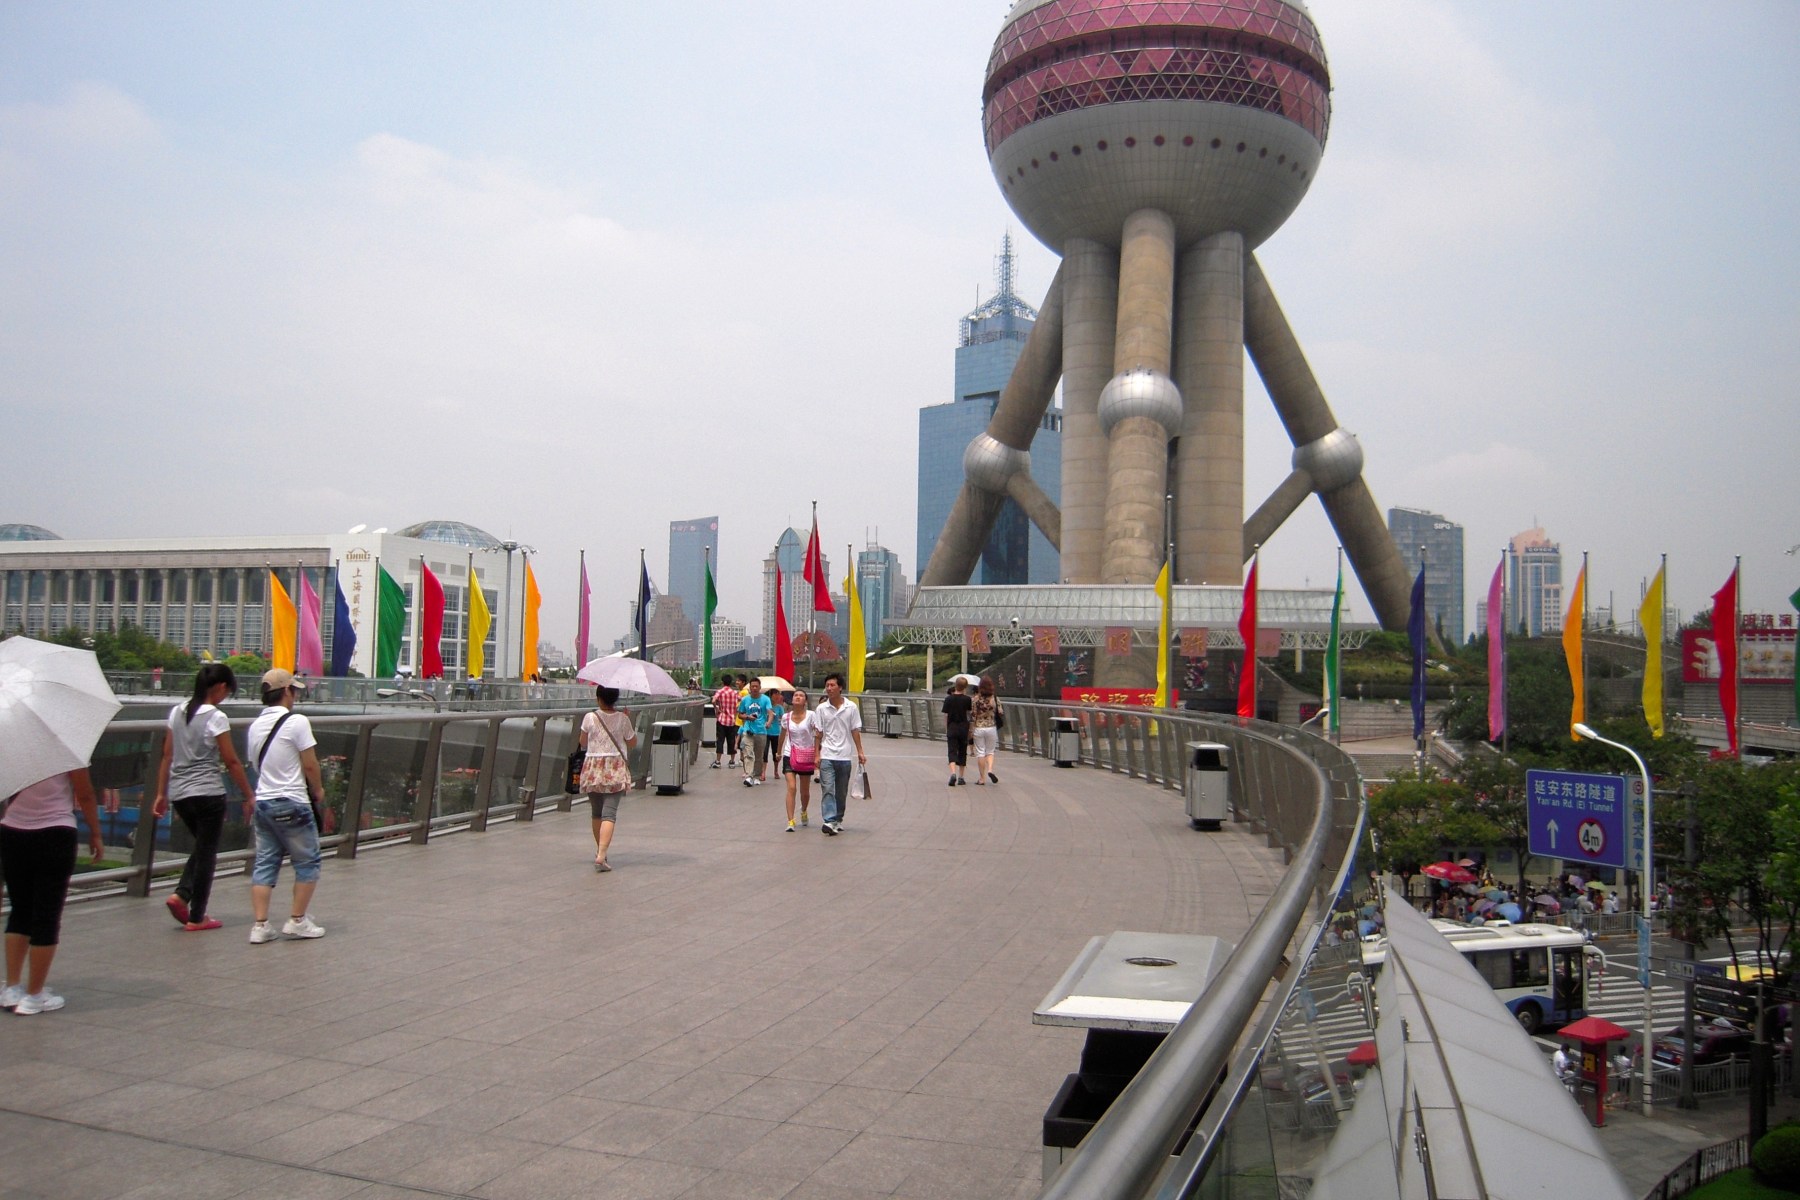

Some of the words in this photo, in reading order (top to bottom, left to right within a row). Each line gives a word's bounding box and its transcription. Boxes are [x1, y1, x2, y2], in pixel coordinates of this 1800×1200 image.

[1534, 779, 1616, 802] 延安东路隧道
[1588, 801, 1614, 813] Tunnel
[1582, 829, 1600, 847] 4m
